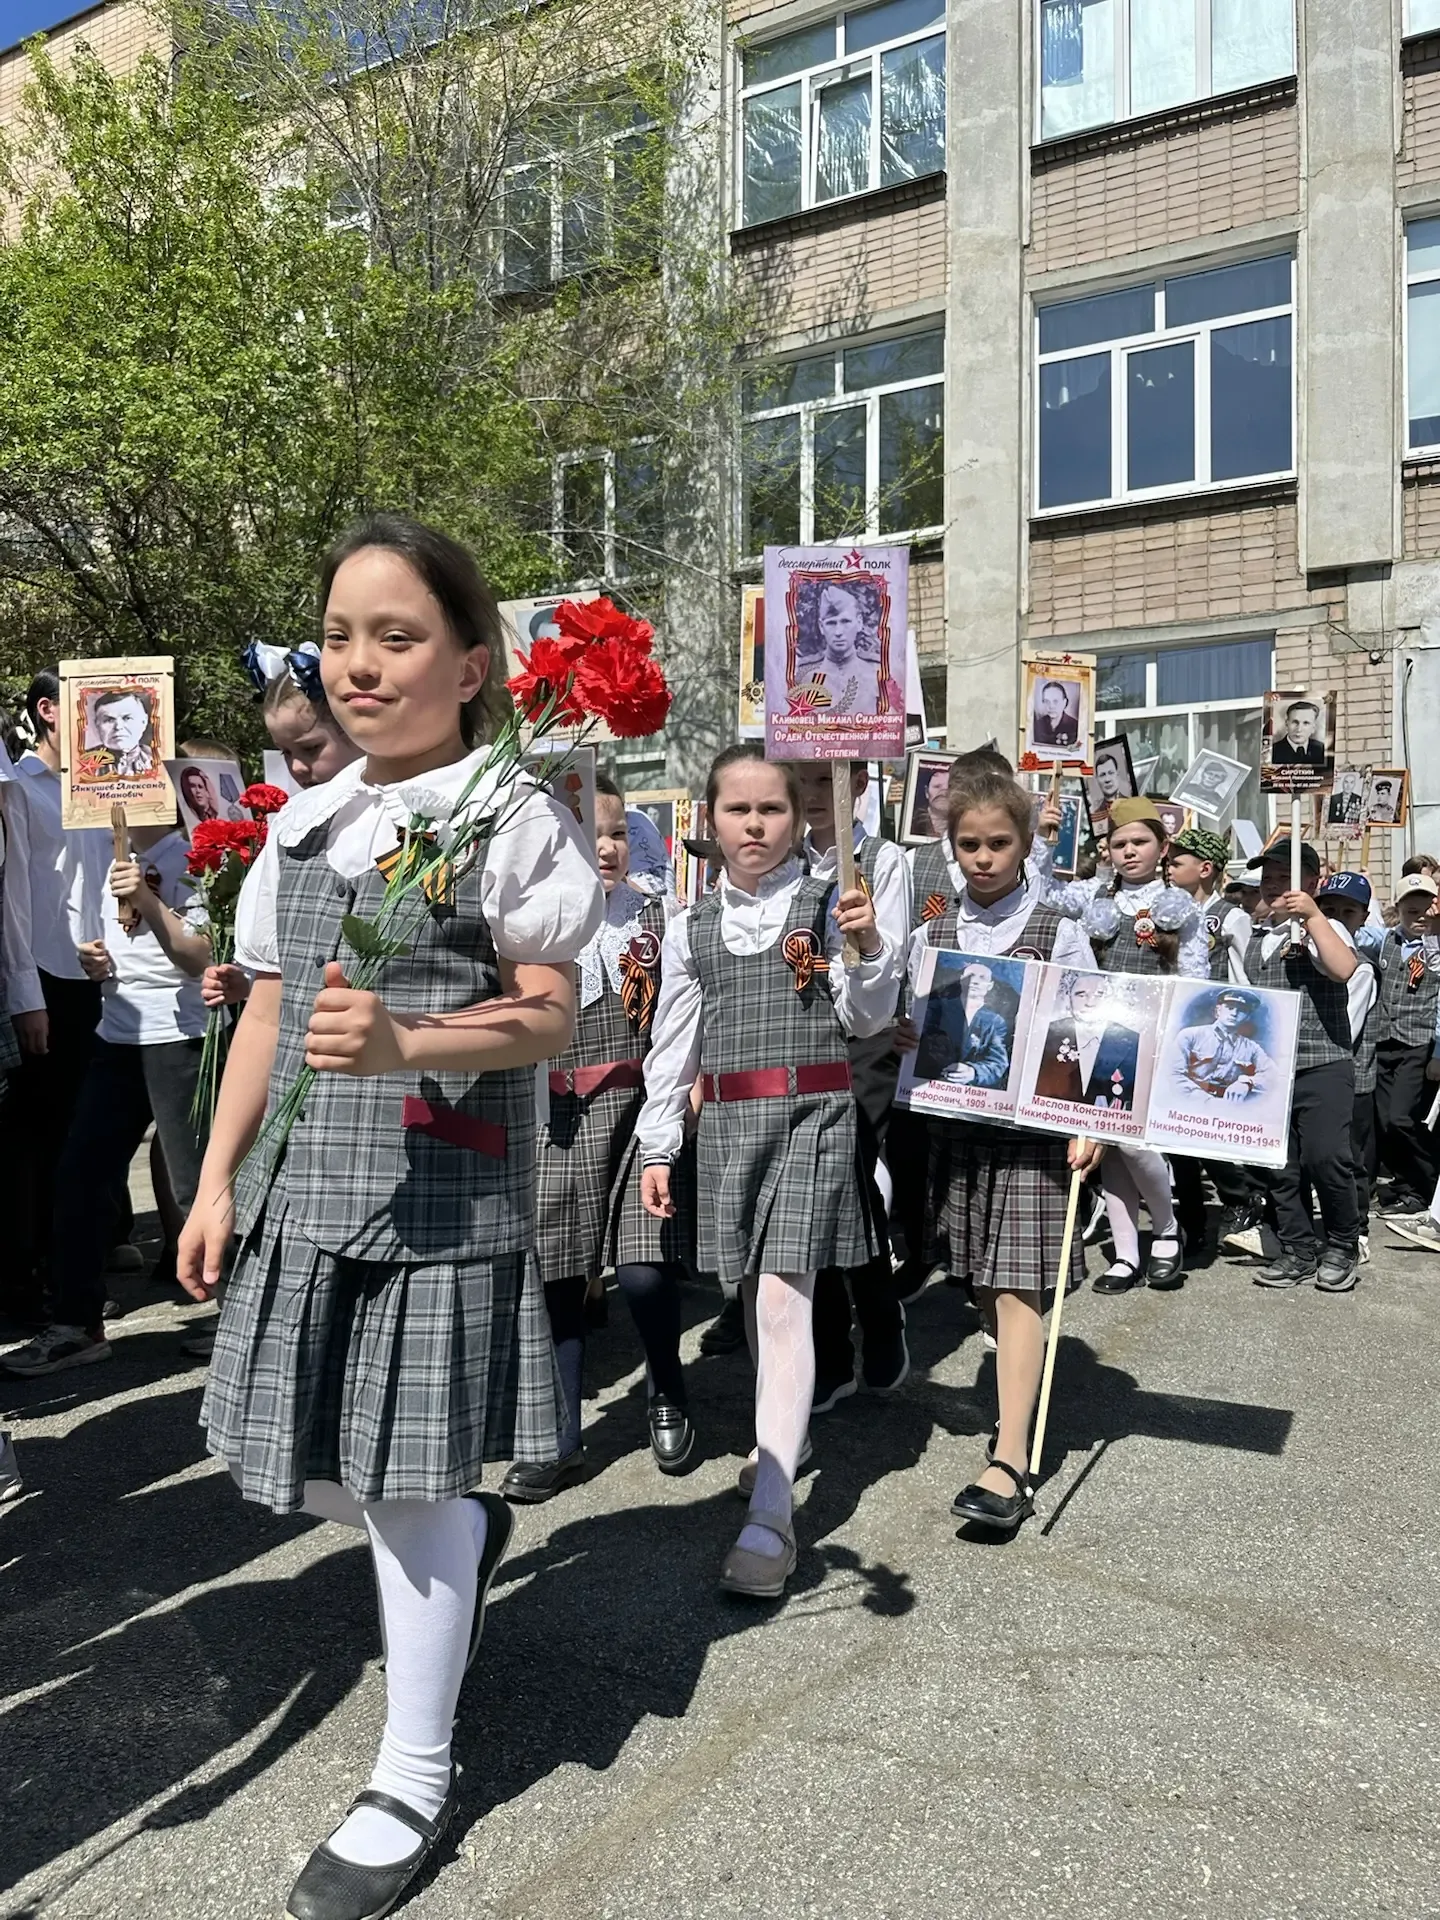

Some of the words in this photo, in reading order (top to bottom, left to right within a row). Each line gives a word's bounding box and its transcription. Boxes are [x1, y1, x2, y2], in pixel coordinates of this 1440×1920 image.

[814, 746, 822, 757] 2
[71, 783, 115, 793] Анкушев
[96, 790, 143, 799] Иванович
[1328, 873, 1352, 890] 17
[928, 1080, 963, 1094] Маслов
[964, 1086, 987, 1097] Иван
[899, 1085, 963, 1106] Никифорович,
[966, 1098, 985, 1109] 1909
[994, 1102, 1014, 1112] 1944
[1032, 1096, 1070, 1111] Маслов
[1072, 1104, 1133, 1121] Константин
[1018, 1106, 1092, 1129] Никифорович,
[1094, 1119, 1144, 1135] 1911-1997
[1167, 1109, 1209, 1125] Маслов
[1211, 1117, 1264, 1134] Григорий
